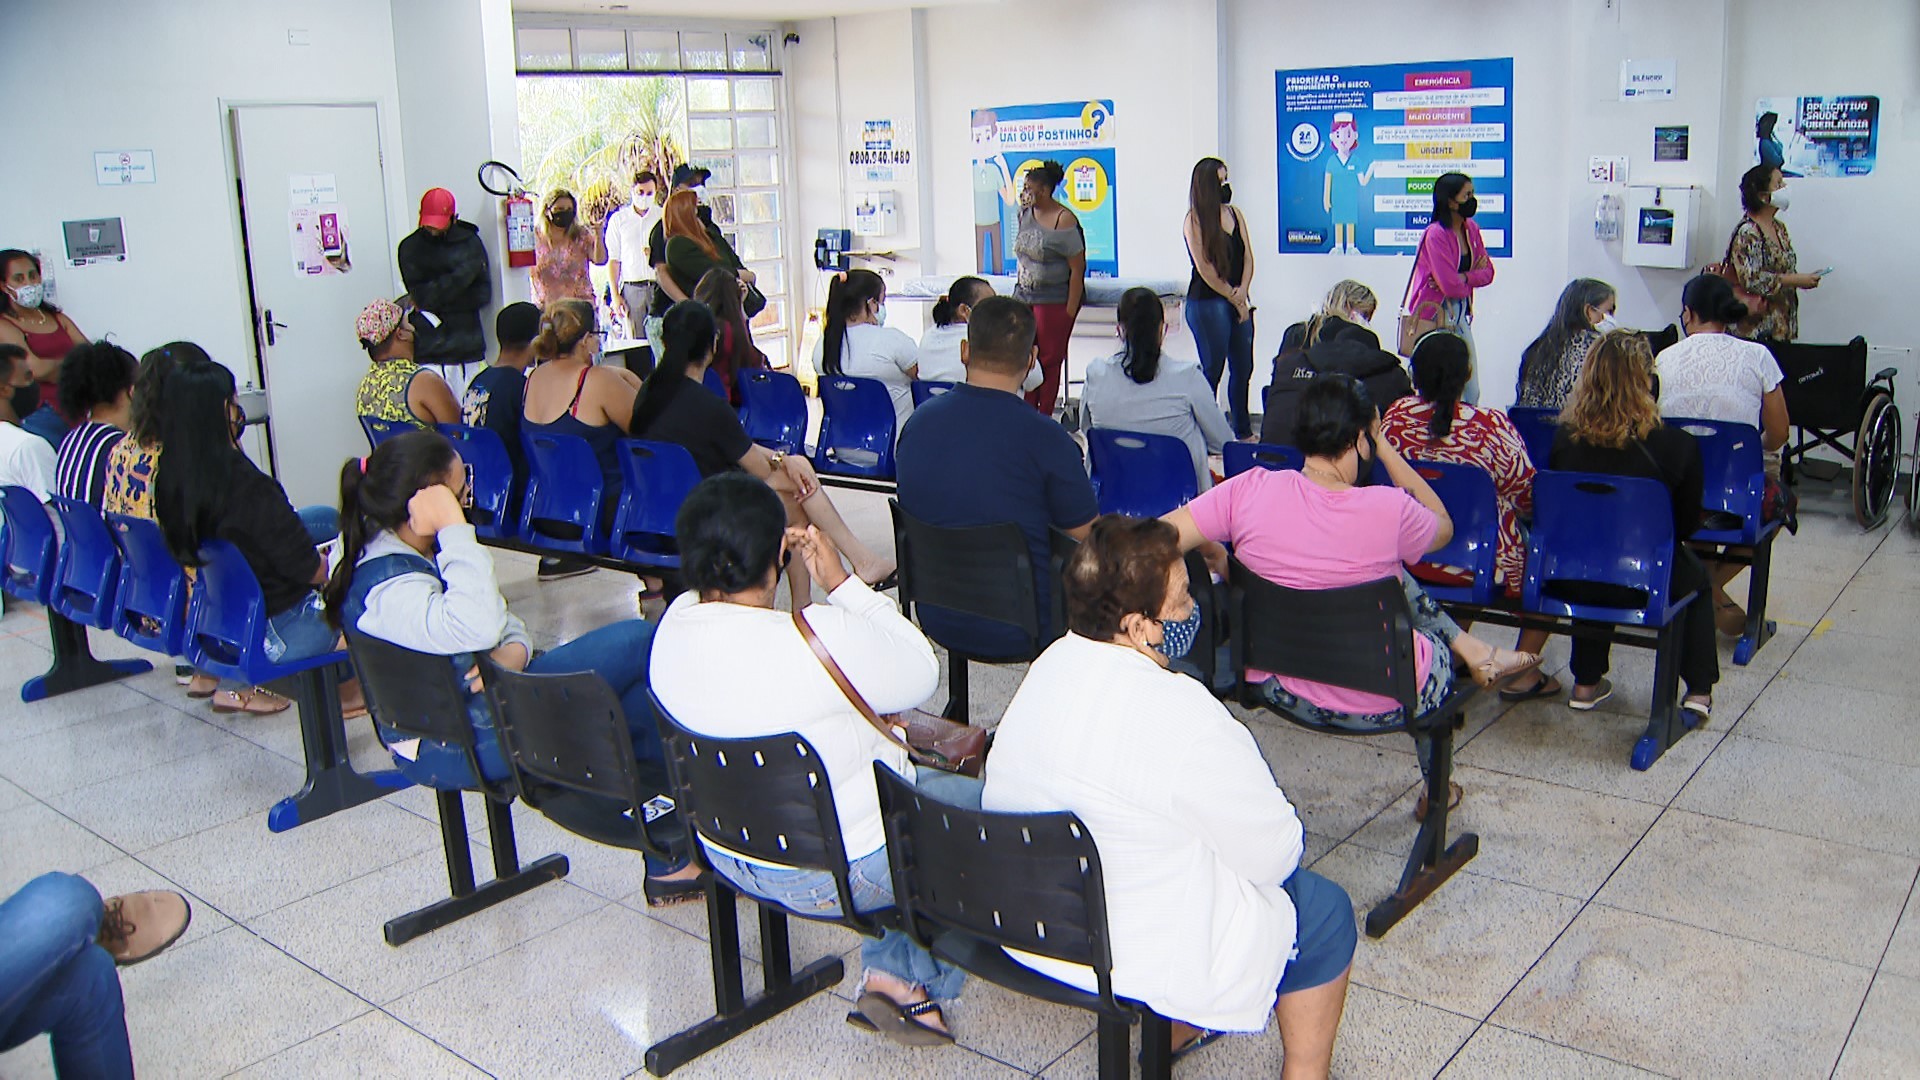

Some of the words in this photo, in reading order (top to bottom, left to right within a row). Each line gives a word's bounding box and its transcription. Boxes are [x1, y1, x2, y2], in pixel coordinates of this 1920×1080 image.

[1414, 77, 1461, 86] EMERGÊNCIA
[1286, 83, 1336, 92] ATENDIMENTO
[1806, 101, 1868, 112] APLICATIVO
[1408, 112, 1431, 120] MUITO
[1432, 112, 1466, 120] URGENTE
[1000, 132, 1017, 142] UAI
[1020, 131, 1035, 141] OU
[1420, 146, 1454, 154] URGENTE
[1408, 182, 1433, 190] POUCO
[1412, 215, 1428, 224] NÃO
